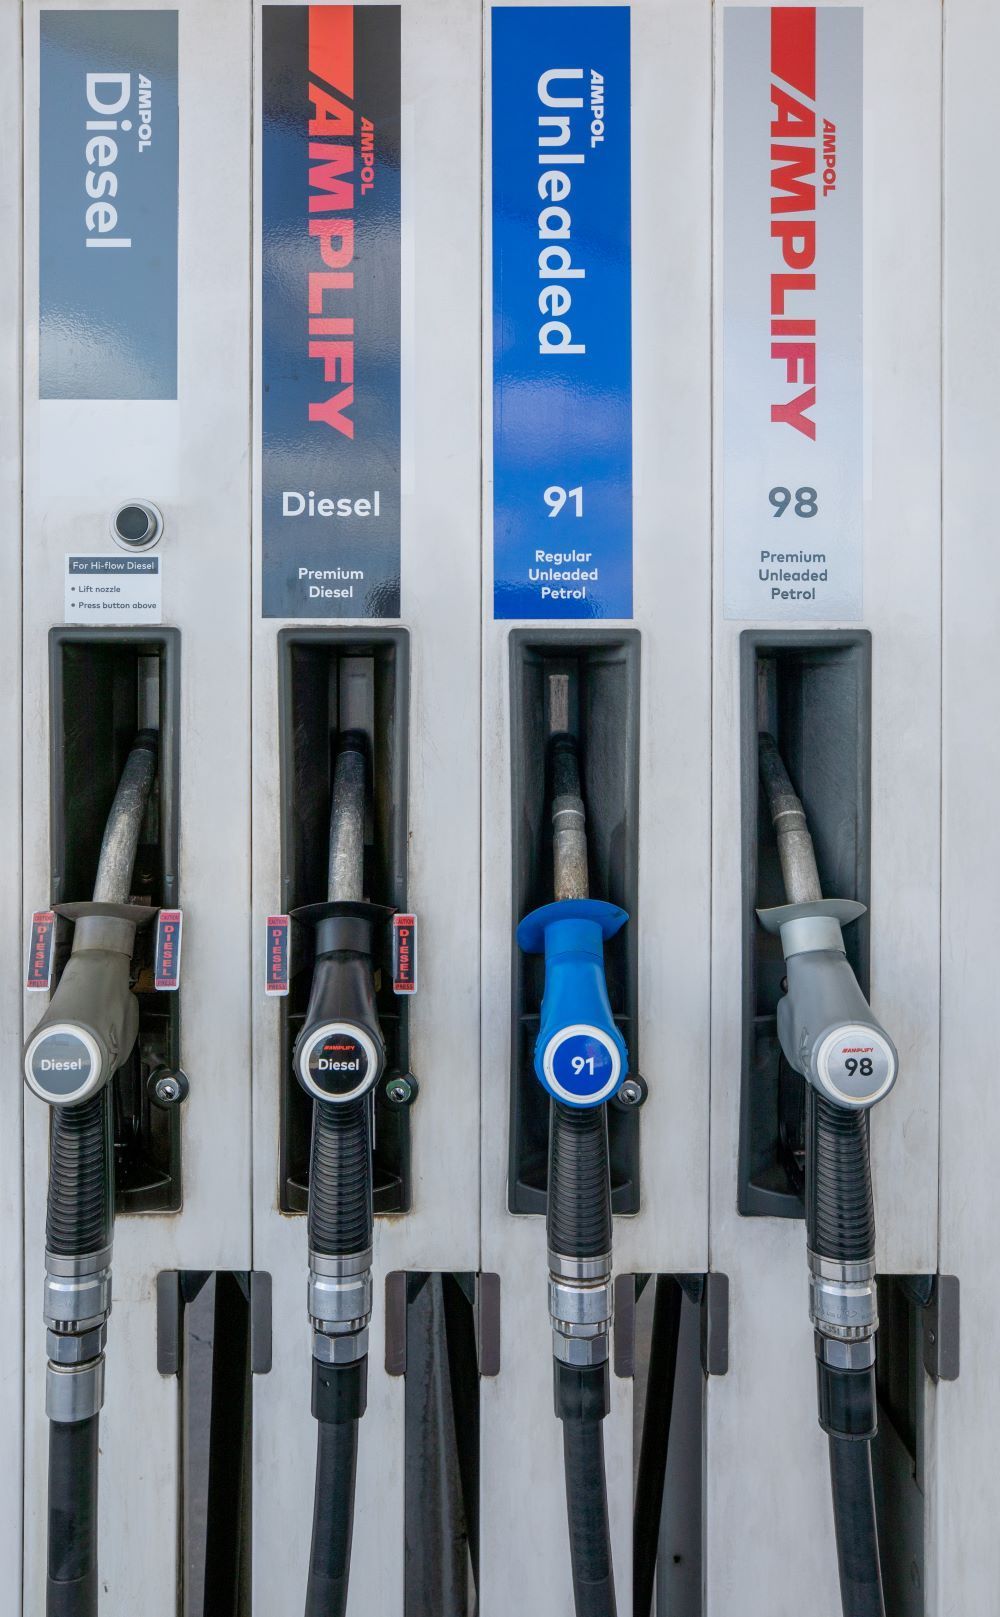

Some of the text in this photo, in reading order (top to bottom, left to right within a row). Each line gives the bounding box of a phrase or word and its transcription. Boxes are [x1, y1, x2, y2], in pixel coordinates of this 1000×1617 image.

[138, 74, 152, 153] AMPOL
[591, 70, 604, 149] AMPOL
[85, 72, 131, 249] Diesel
[360, 116, 375, 195] AMPOL
[822, 118, 836, 197] AMPOL
[537, 68, 586, 355] Unleaded
[308, 82, 354, 441] AMPLIFY
[770, 83, 816, 442] AMPLIFY
[282, 490, 381, 518] Diesel
[543, 485, 584, 518] 91
[768, 486, 819, 519] 98
[72, 561, 155, 570] For Hi-flow Diesel
[534, 549, 592, 565] Regular
[760, 550, 826, 564] Premium
[298, 567, 364, 581] Premium
[528, 568, 599, 582] Unleaded
[758, 568, 829, 582] Unleaded
[78, 585, 94, 593] Lift
[308, 585, 354, 599] Diesel
[540, 586, 587, 600] Petrol
[770, 586, 817, 600] Petrol
[34, 926, 47, 977] DIESEL
[162, 925, 175, 976] DIESEL
[272, 929, 282, 980] DIESEL
[399, 929, 410, 980] DIESEL
[41, 1058, 82, 1071] Diesel
[318, 1058, 360, 1071] Diesel
[571, 1056, 594, 1076] 91
[844, 1057, 874, 1077] 98
